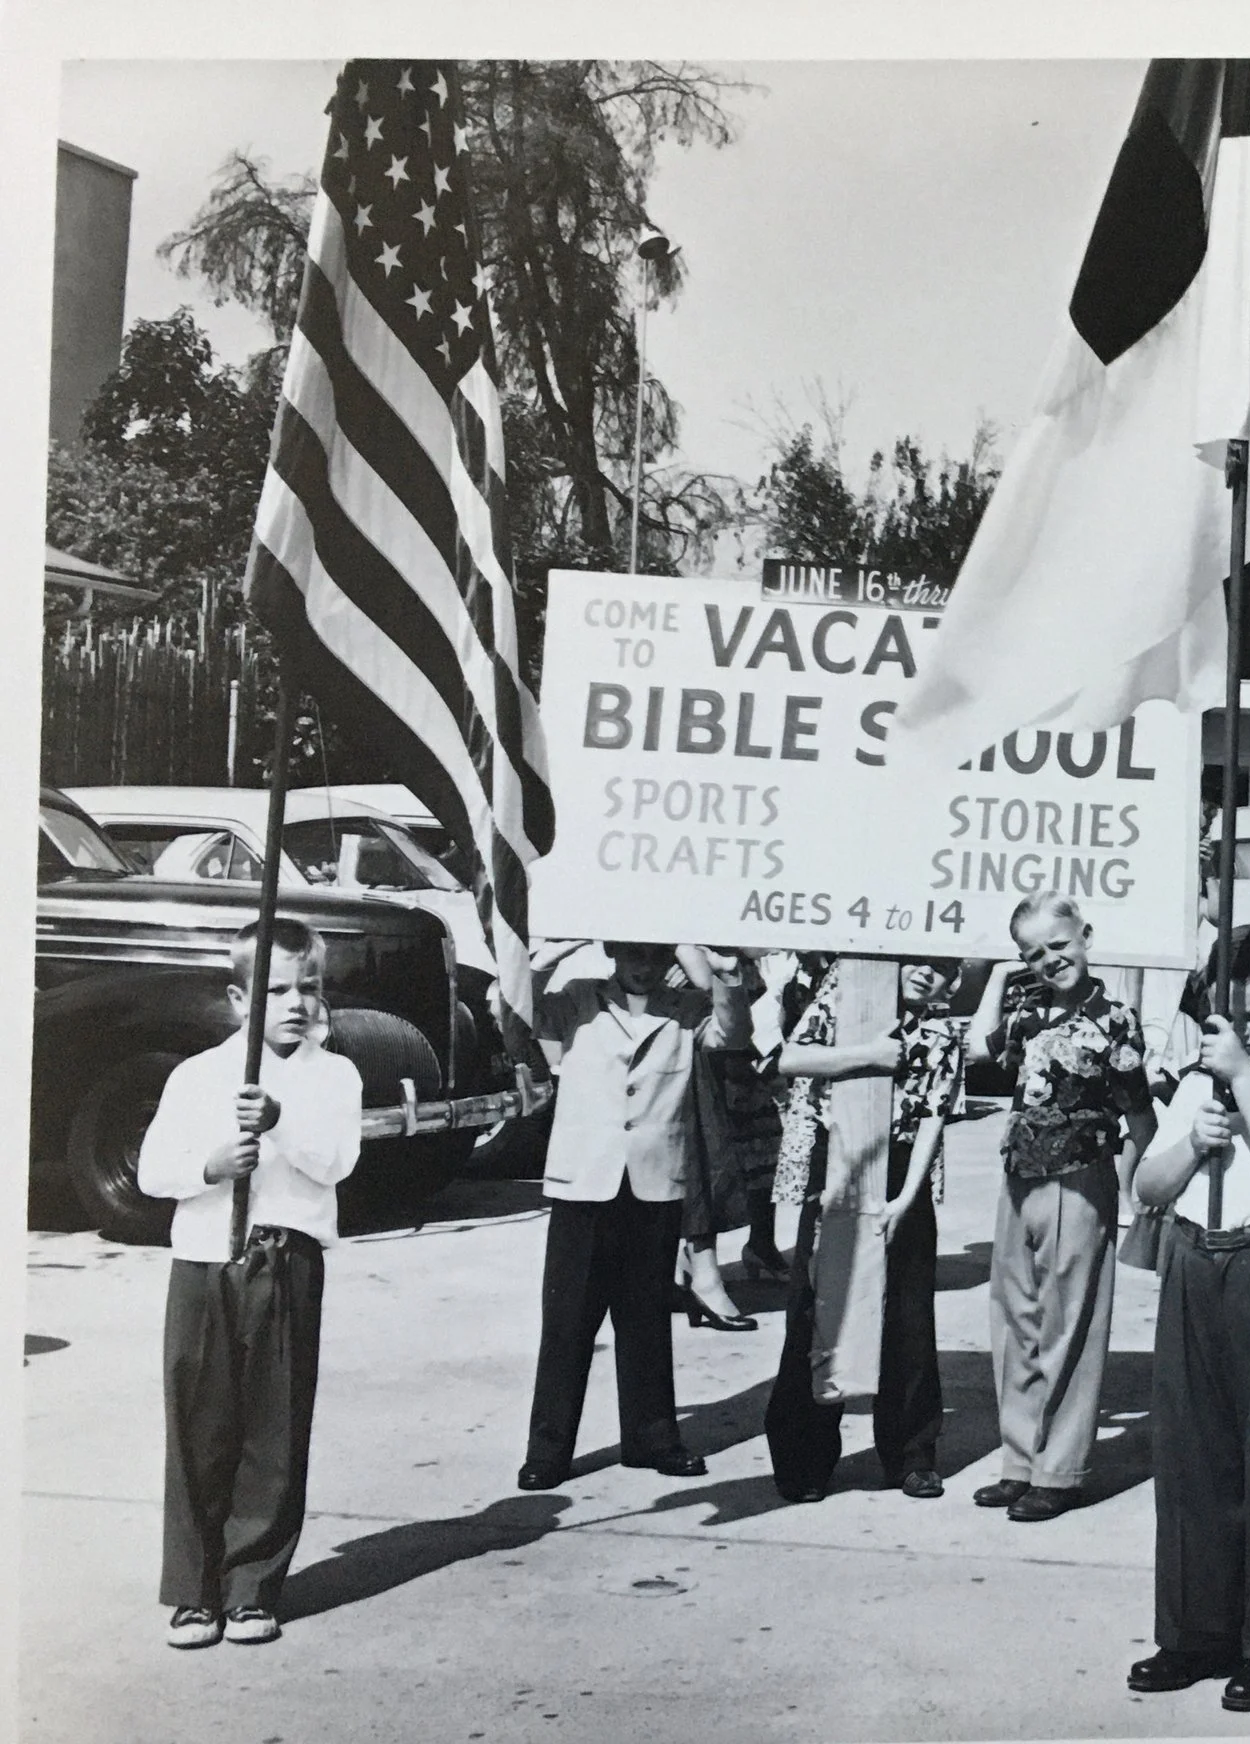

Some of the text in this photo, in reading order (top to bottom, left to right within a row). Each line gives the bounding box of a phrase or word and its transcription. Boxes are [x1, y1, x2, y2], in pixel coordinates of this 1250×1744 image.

[764, 565, 843, 600] JUNE
[584, 599, 679, 632] COME
[704, 603, 941, 678] VACA
[614, 638, 655, 668] TO
[583, 682, 1156, 781] BIBLE SOOL
[604, 776, 1140, 848] SPORTS STORIES
[599, 830, 1135, 899] CRAFTS SINGING
[740, 890, 965, 933] AGES 4 to 14
